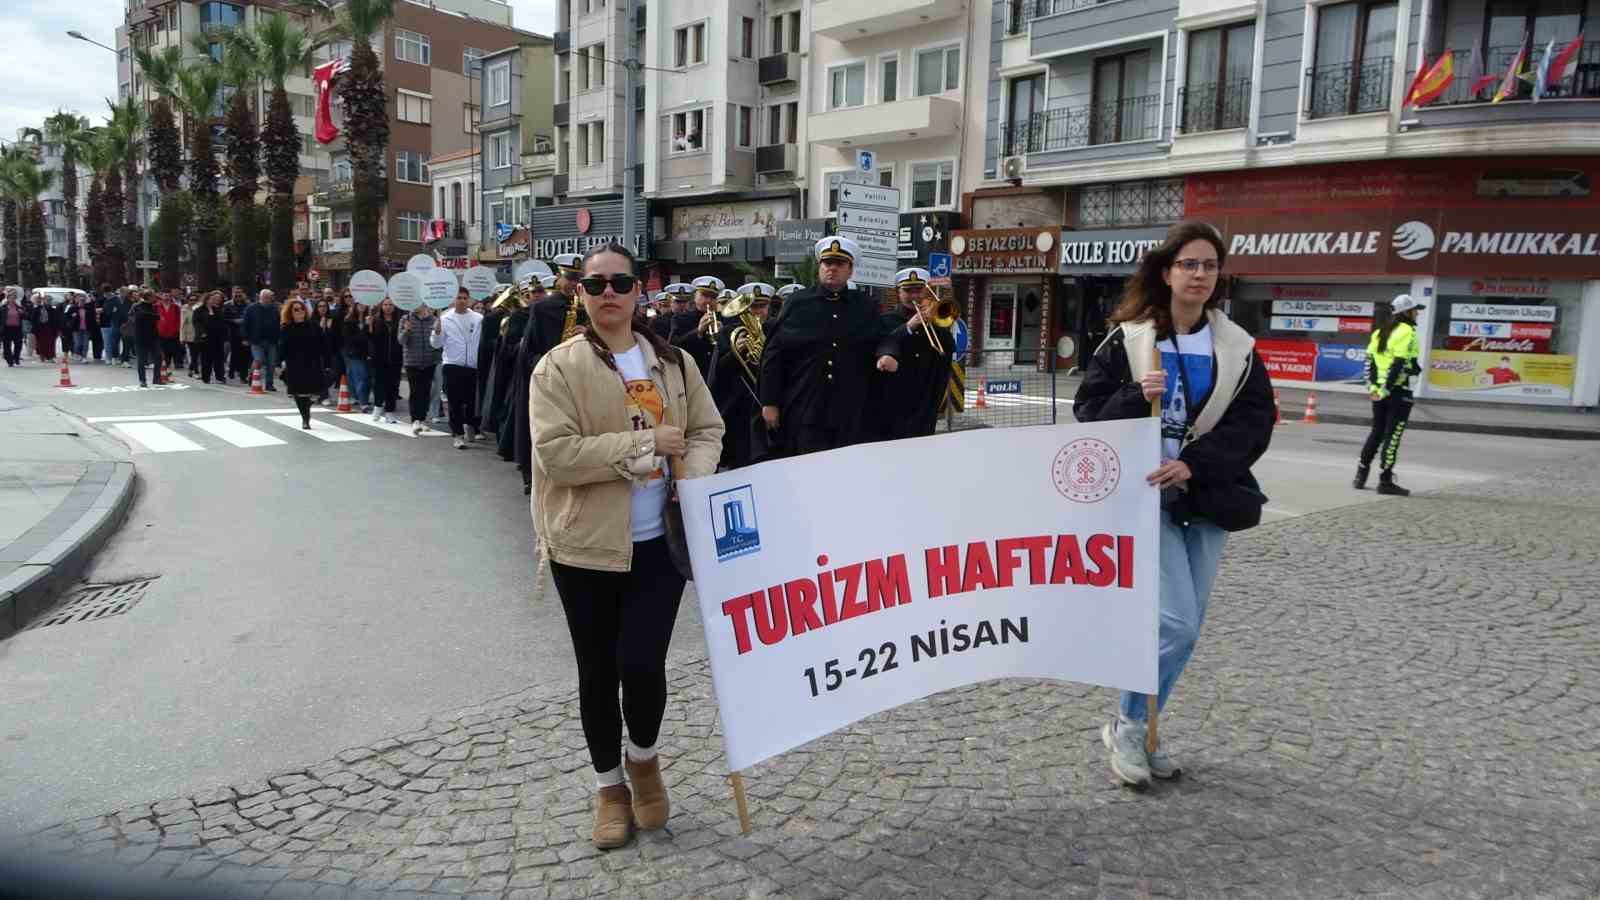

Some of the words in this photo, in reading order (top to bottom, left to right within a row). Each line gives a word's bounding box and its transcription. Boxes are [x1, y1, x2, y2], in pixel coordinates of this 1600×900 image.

[535, 238, 579, 258] HOTEL
[1060, 240, 1104, 264] KULE
[1228, 231, 1382, 255] PAMUKKALE
[1439, 231, 1600, 255] PAMUKKAL
[1008, 254, 1047, 268] ALTIN
[721, 554, 913, 656] TURİZM
[924, 533, 1135, 599] HAFTASI
[803, 641, 899, 698] 15-22
[911, 615, 1030, 663] NİSAN
